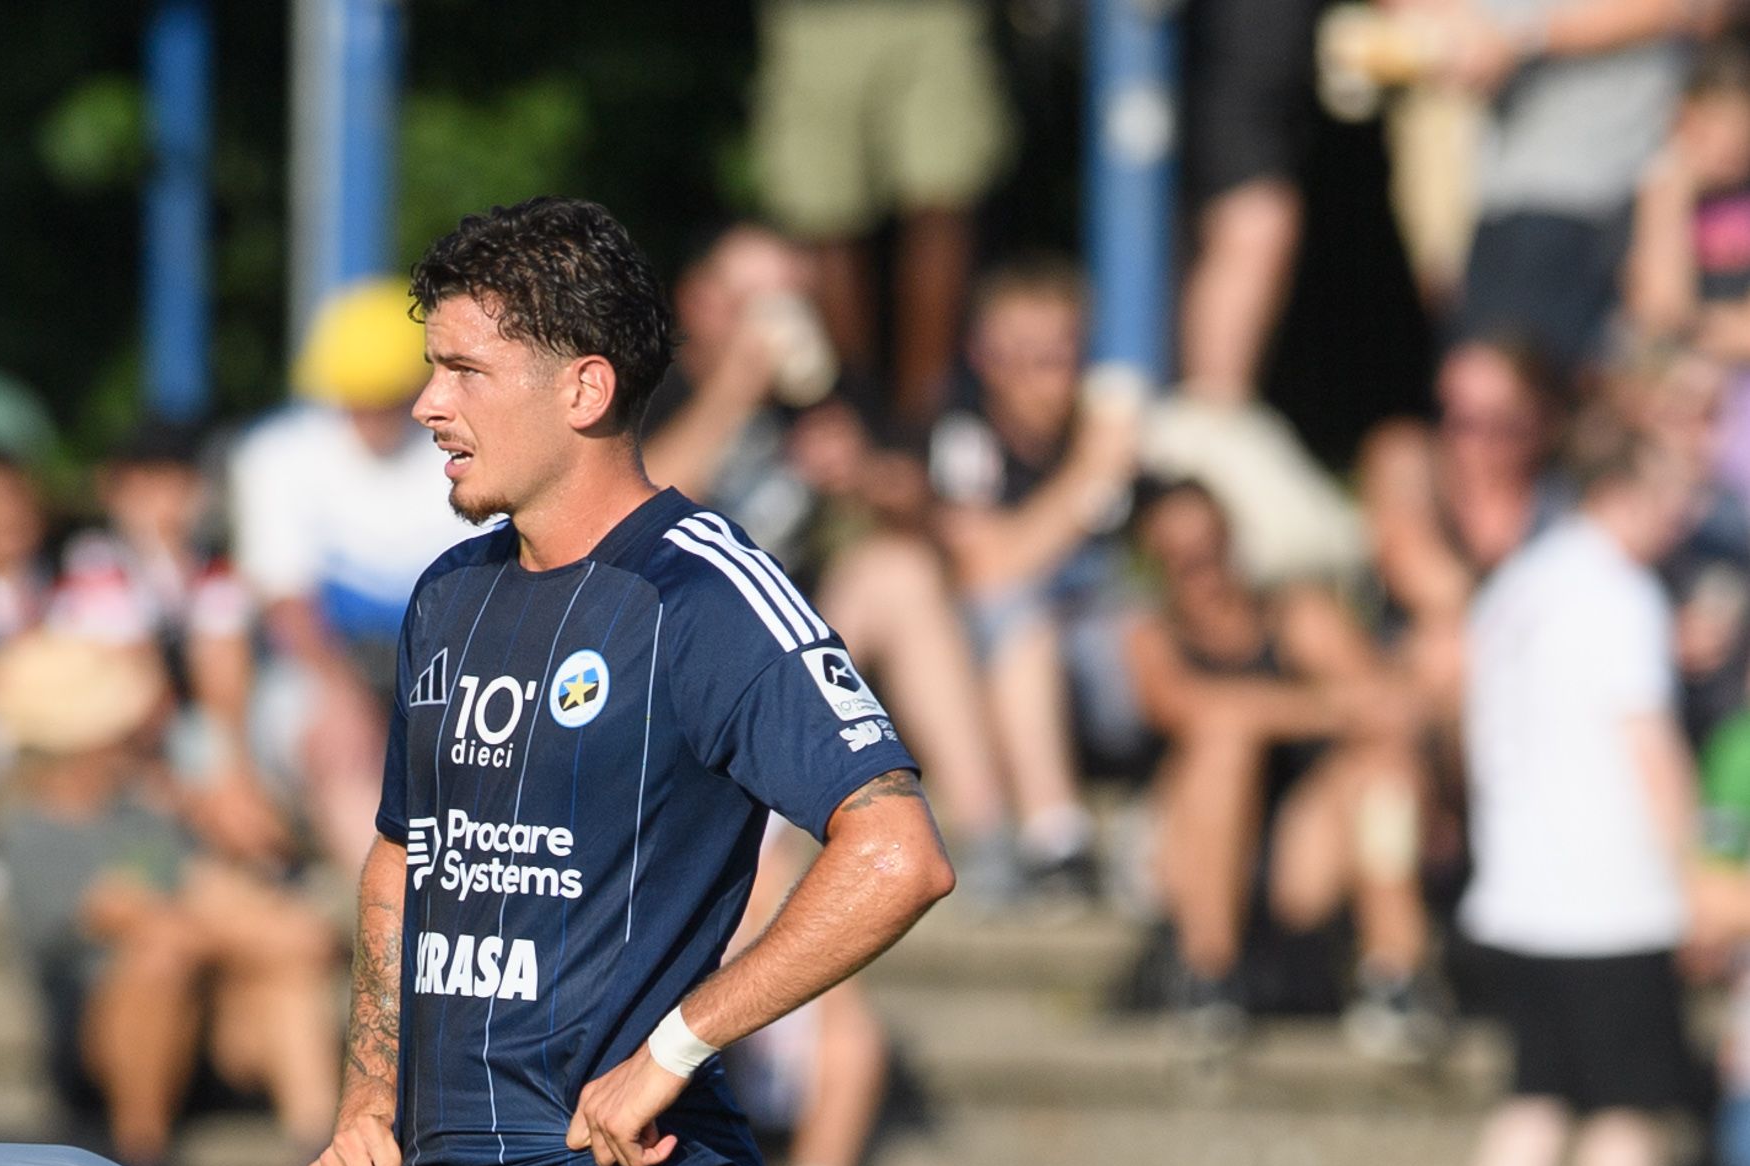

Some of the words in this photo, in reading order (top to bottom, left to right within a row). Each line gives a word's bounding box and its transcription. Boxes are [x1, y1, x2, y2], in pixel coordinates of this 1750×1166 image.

[451, 739, 514, 768] dieci
[446, 808, 574, 857] Procare
[440, 850, 583, 901] Systems
